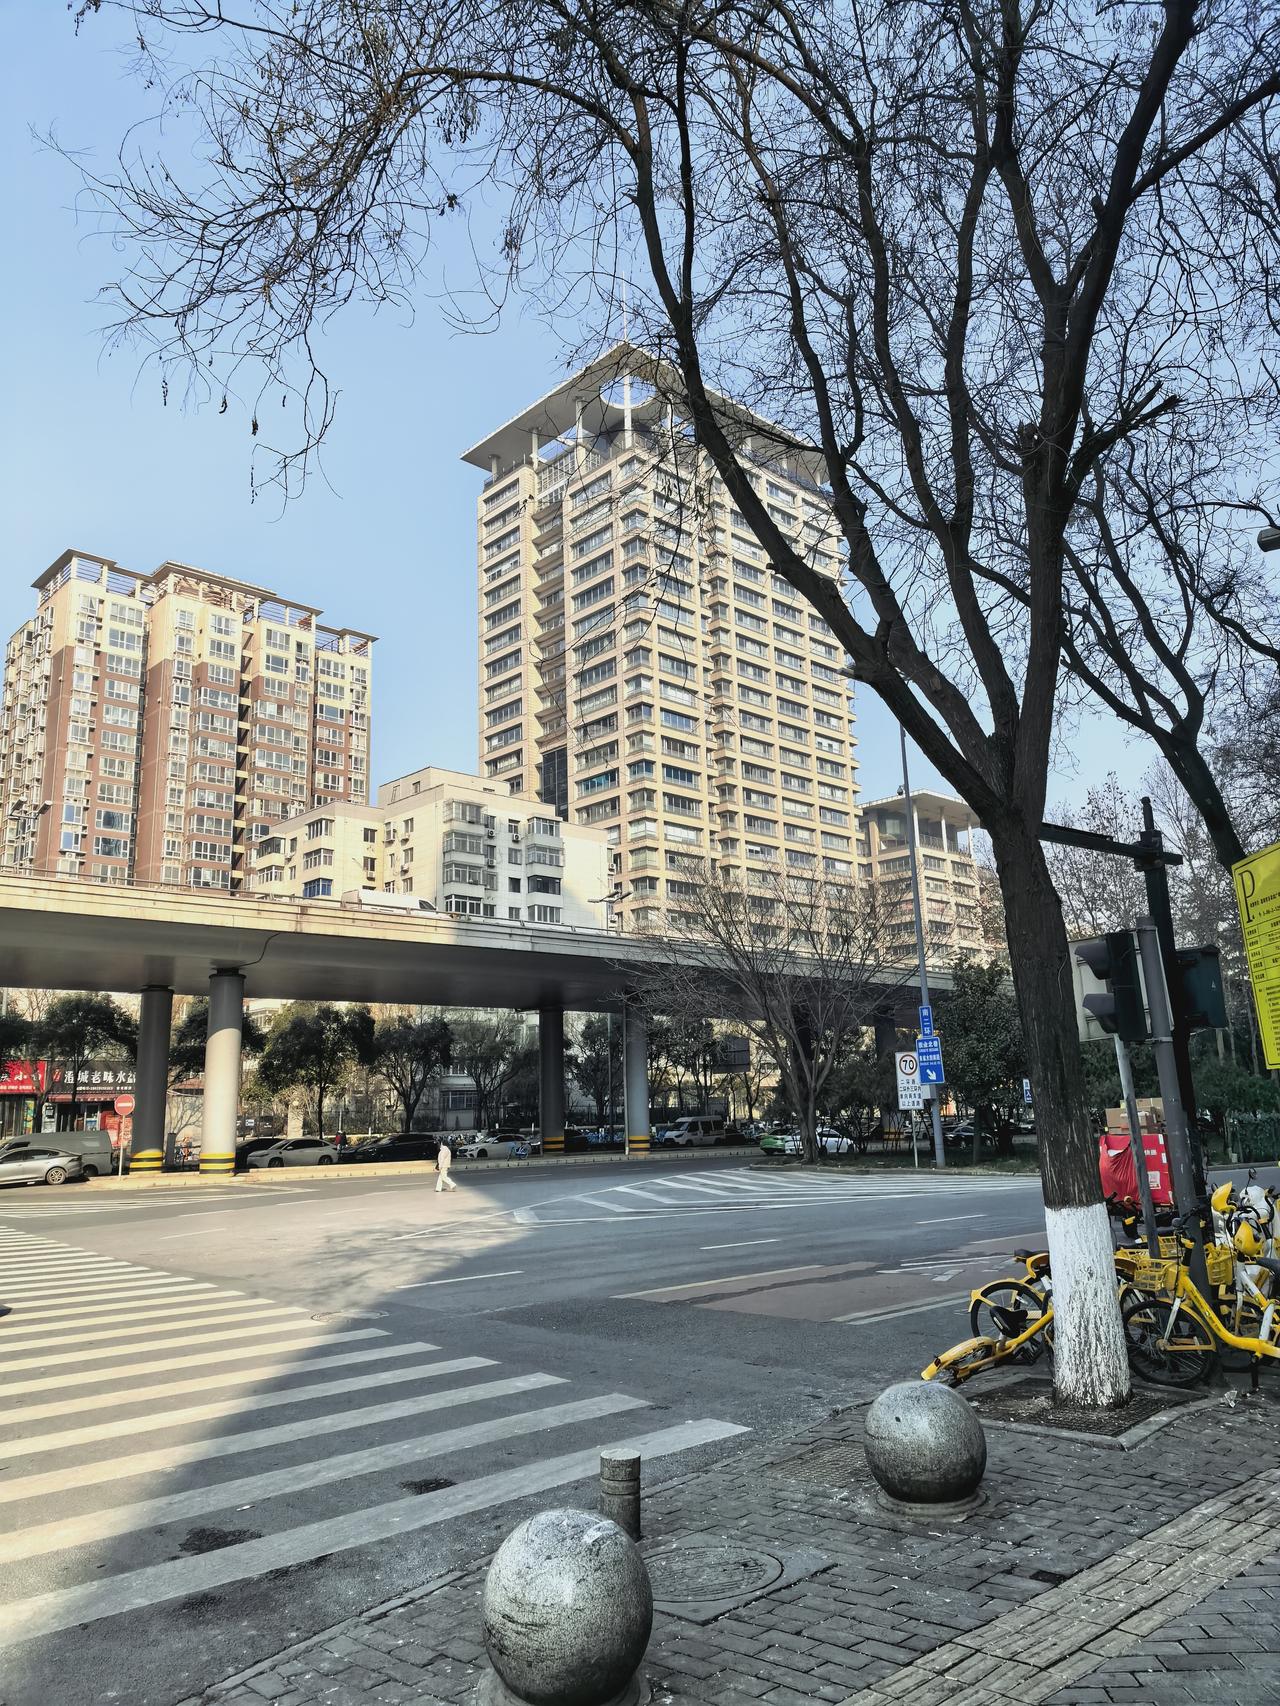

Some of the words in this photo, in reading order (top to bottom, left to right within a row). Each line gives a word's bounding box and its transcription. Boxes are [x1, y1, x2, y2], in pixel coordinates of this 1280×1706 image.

[922, 1008, 931, 1035] 南二环
[902, 1059, 914, 1071] 70
